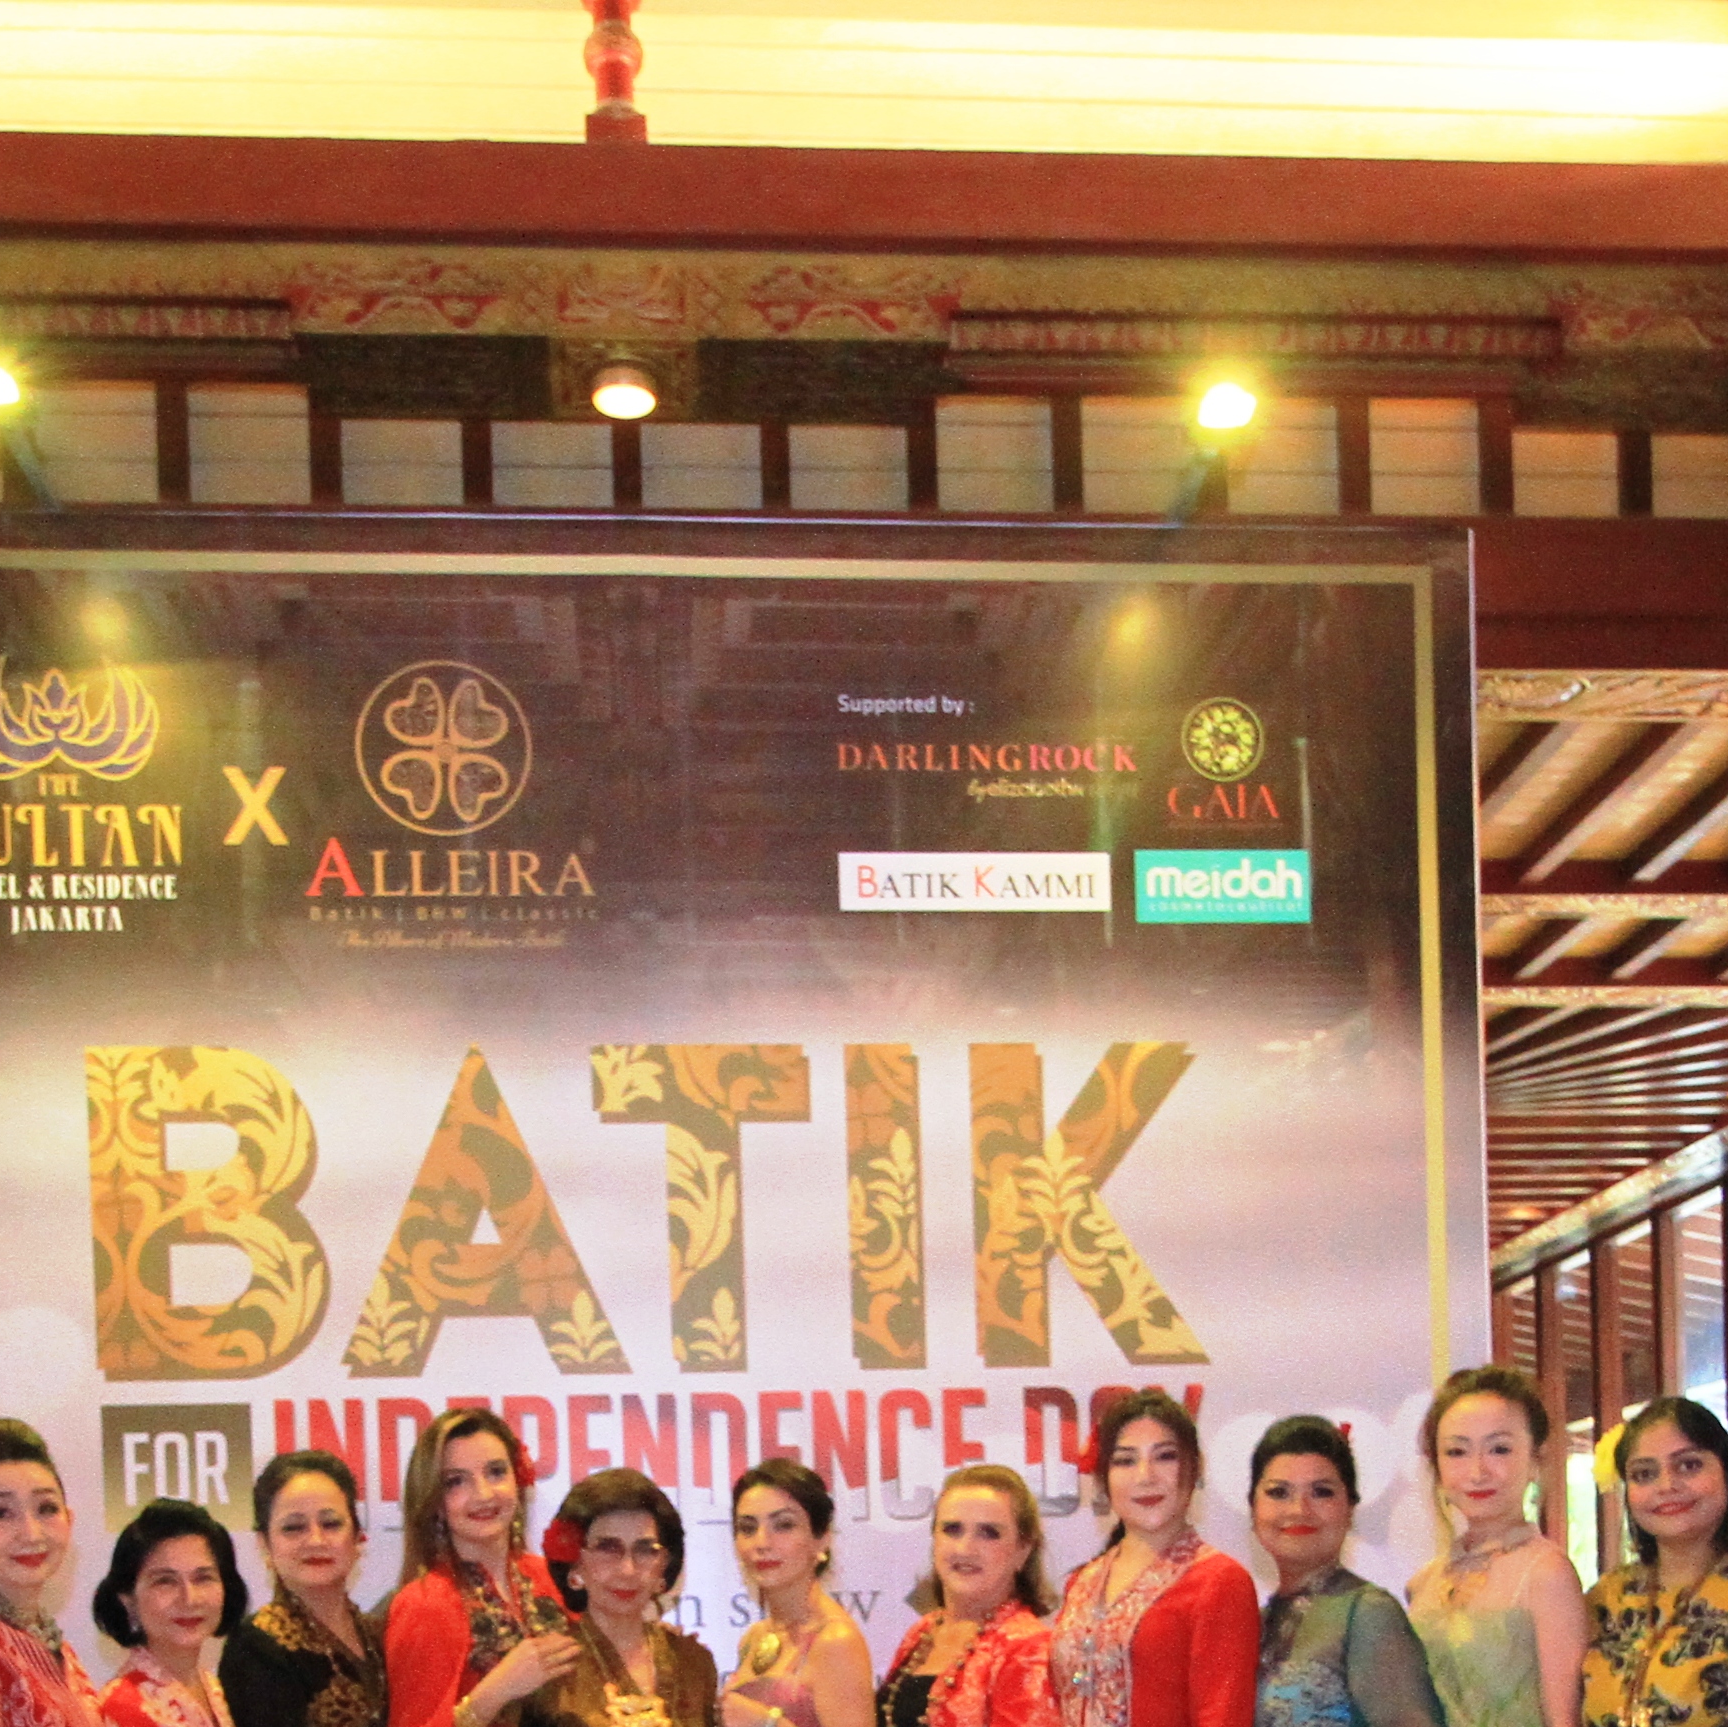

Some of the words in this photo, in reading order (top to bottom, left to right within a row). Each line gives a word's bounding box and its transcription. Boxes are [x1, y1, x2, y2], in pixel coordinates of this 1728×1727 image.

[838, 694, 936, 715] Supported
[940, 694, 965, 716] by
[836, 741, 1138, 773] DARLINGROCK
[38, 773, 81, 796] THE
[1167, 782, 1281, 820] GAIA
[222, 766, 289, 847] X
[305, 837, 596, 897] ALLEIRA
[856, 864, 964, 899] BATIK
[974, 864, 1096, 899] KAMMI
[1145, 857, 1304, 901] meidah
[27, 873, 46, 900] &
[51, 873, 178, 900] RESIDENCE
[10, 905, 124, 935] JAKARTA
[84, 1040, 1212, 1382] BATIK
[122, 1430, 231, 1507] FOR
[273, 1386, 987, 1530] INDPENDENCE
